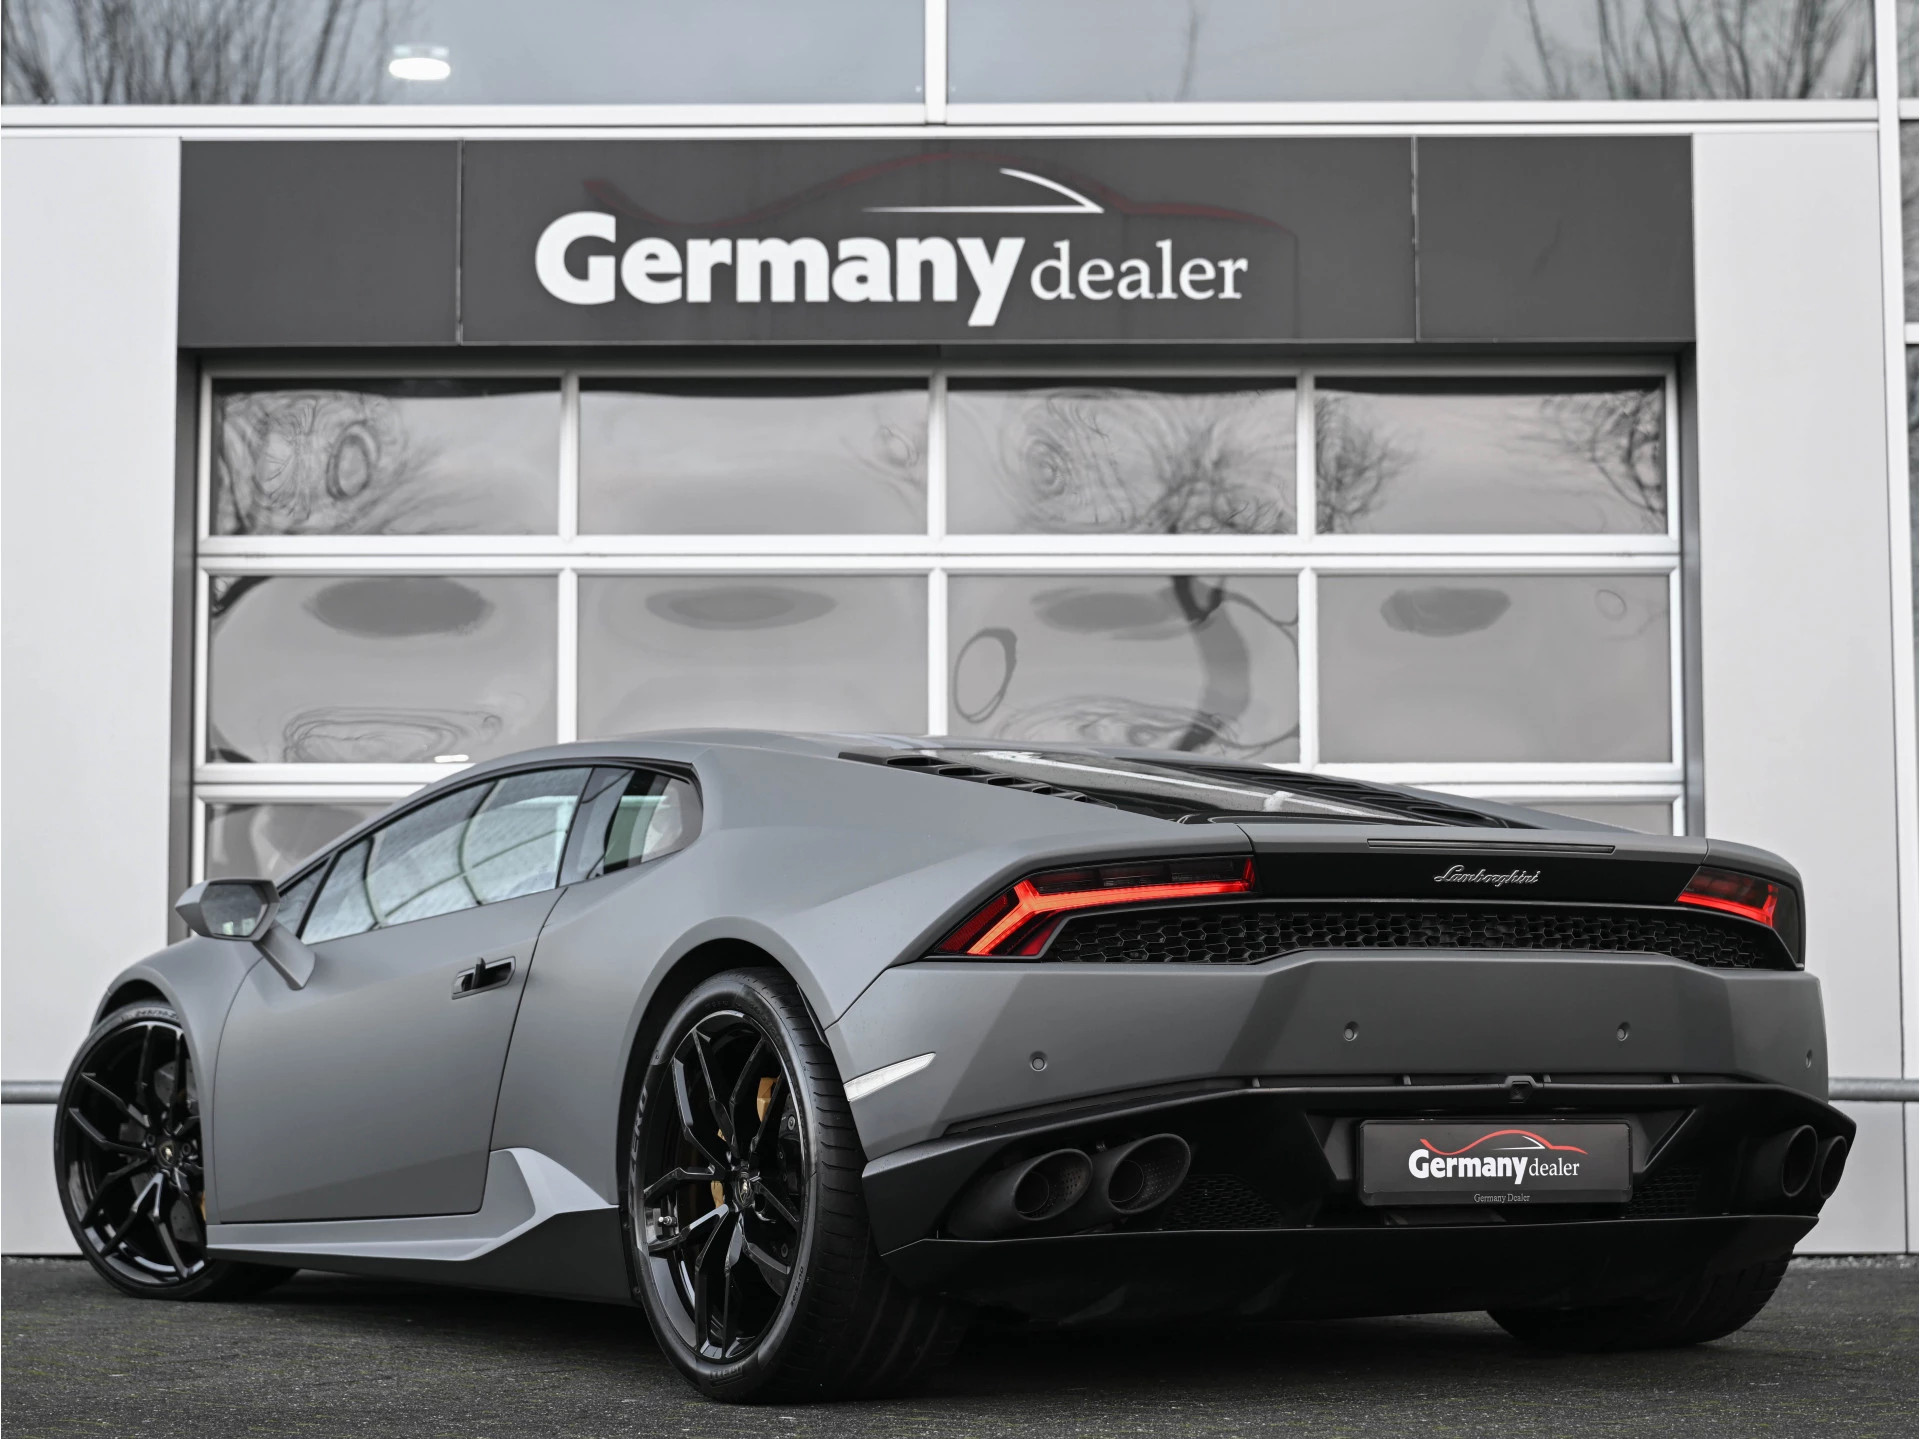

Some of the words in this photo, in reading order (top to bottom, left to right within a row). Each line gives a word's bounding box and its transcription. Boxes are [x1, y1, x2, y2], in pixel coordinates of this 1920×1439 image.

[535, 211, 1025, 326] Germany
[1030, 239, 1249, 301] dealer
[1434, 864, 1541, 887] Lamborghini
[1408, 1149, 1528, 1185] Germany
[1529, 1157, 1580, 1177] dealer
[1473, 1193, 1507, 1203] Germany
[1507, 1193, 1530, 1202] Dealer
